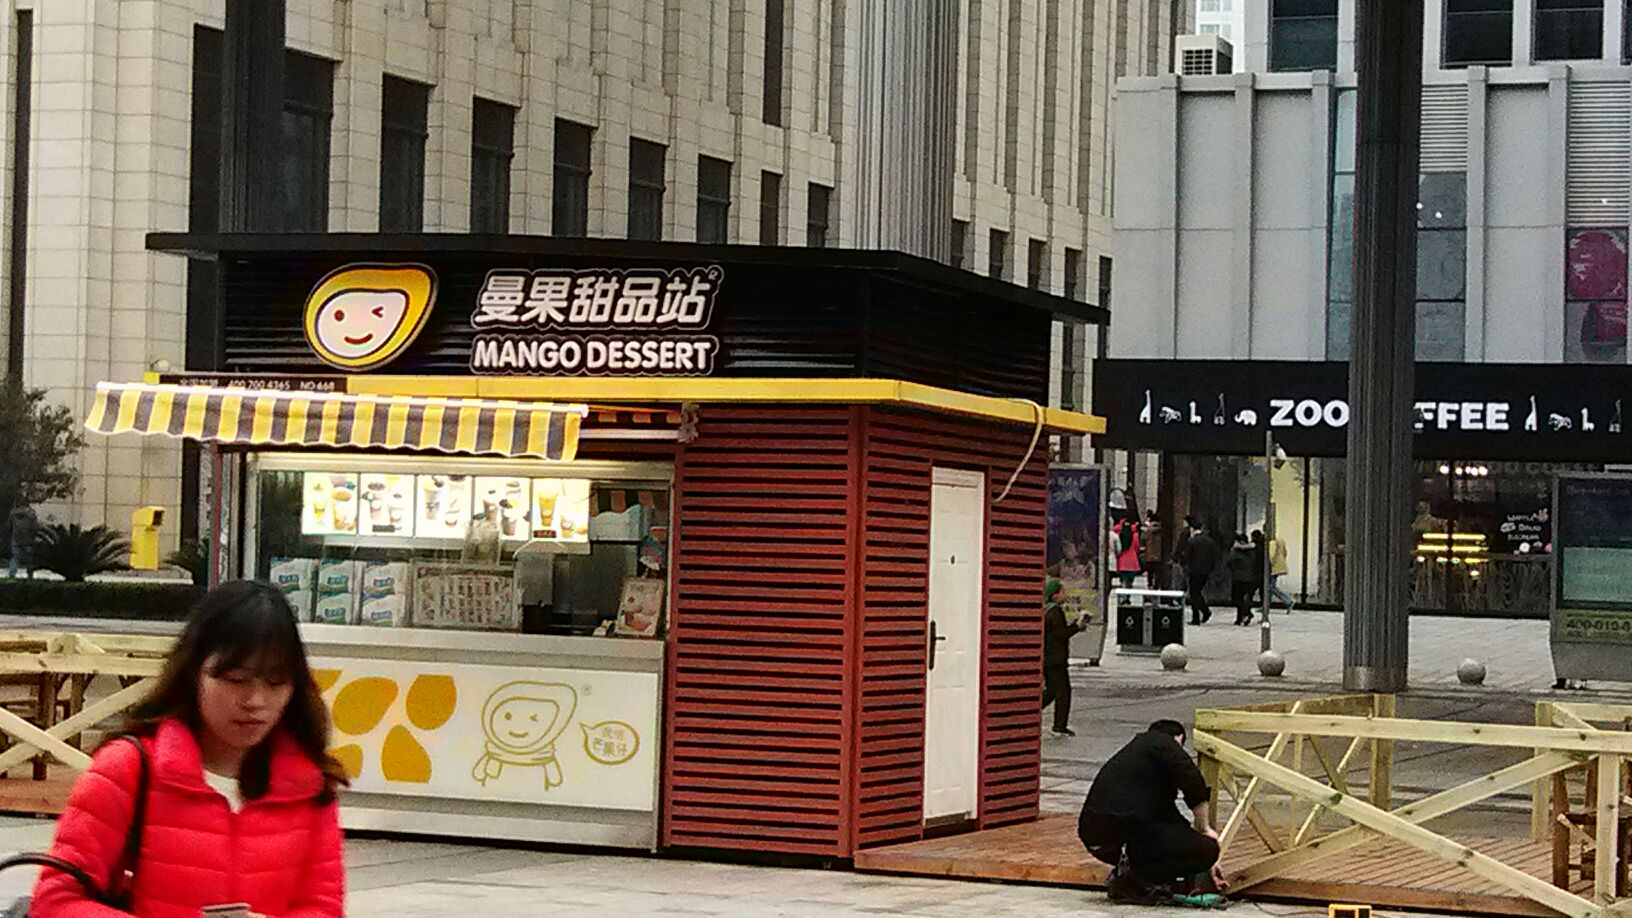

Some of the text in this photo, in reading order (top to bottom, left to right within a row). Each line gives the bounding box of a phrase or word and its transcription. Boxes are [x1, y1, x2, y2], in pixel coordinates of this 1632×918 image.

[474, 276, 711, 324] 曼果甜品站
[473, 340, 712, 370] MANGO DESSERT
[1269, 399, 1510, 431] ZOO FFEE
